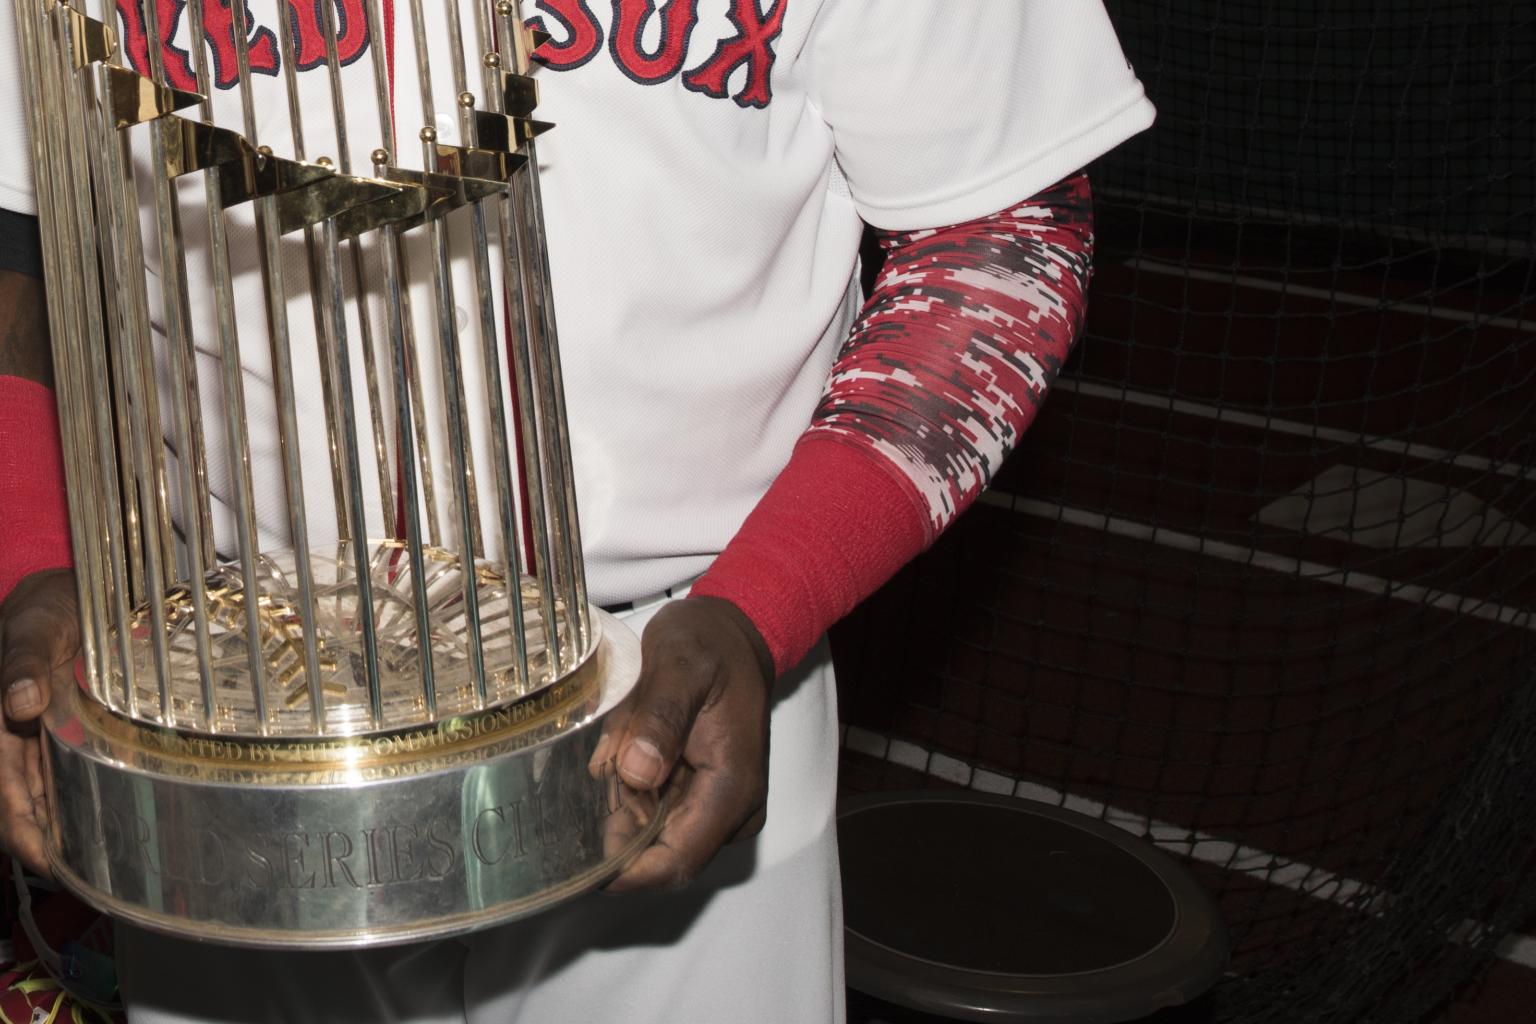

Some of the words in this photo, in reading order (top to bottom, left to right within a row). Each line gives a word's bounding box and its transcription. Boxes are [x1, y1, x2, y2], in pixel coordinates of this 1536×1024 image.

[249, 742, 280, 763] BY
[357, 697, 537, 758] COMMISSIONER
[238, 817, 456, 890] SERIES
